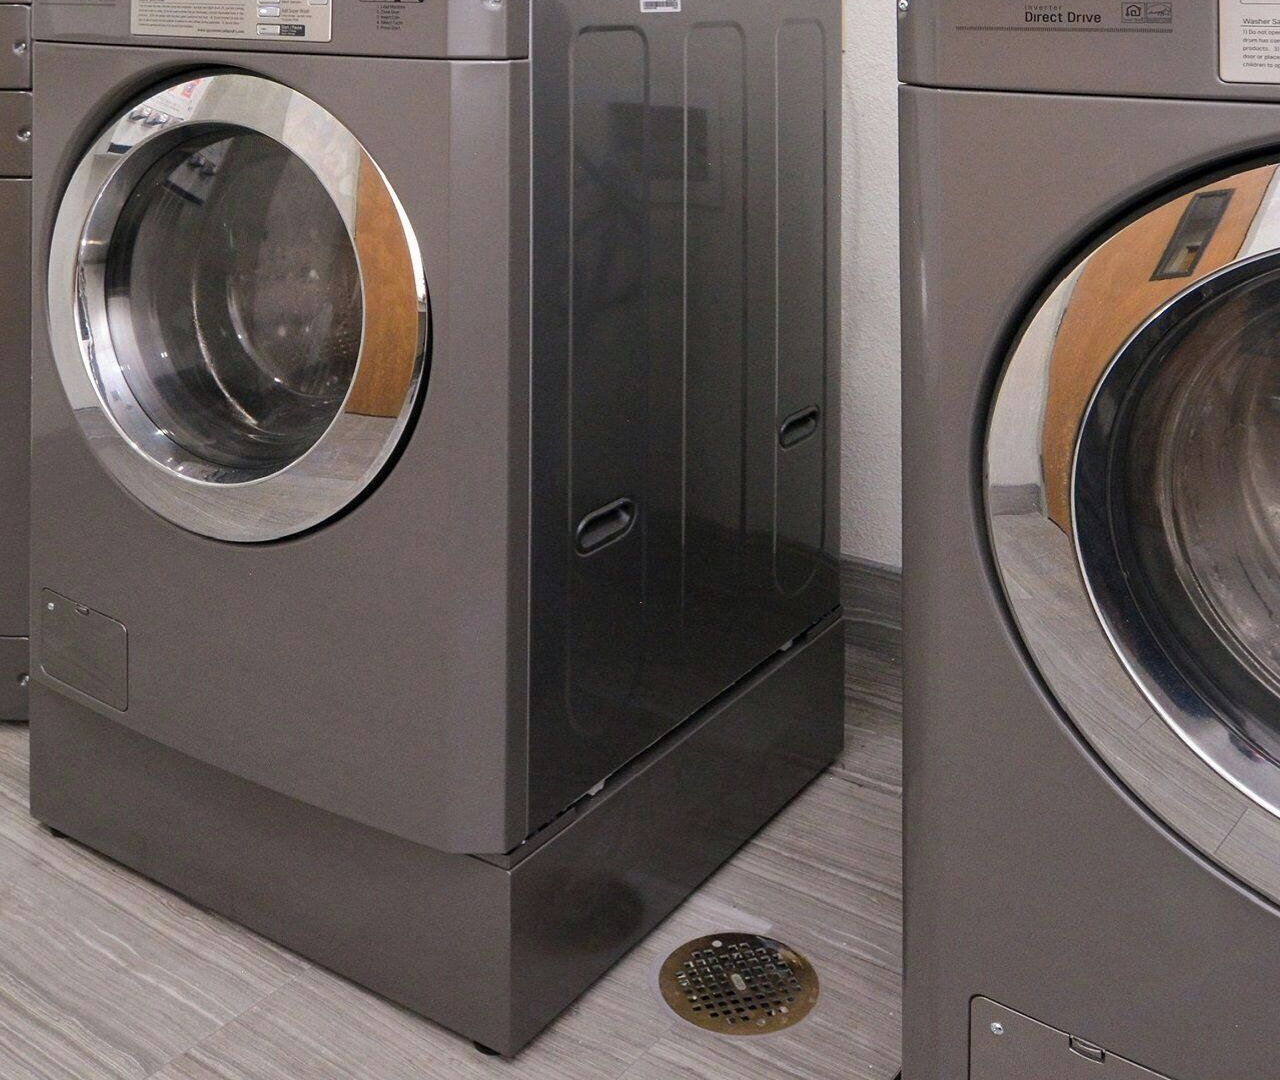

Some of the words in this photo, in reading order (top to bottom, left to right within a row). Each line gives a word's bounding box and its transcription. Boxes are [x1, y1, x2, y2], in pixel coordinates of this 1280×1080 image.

[1025, 11, 1063, 23] Direct
[1067, 11, 1102, 23] Drive
[1242, 18, 1270, 26] Washer
